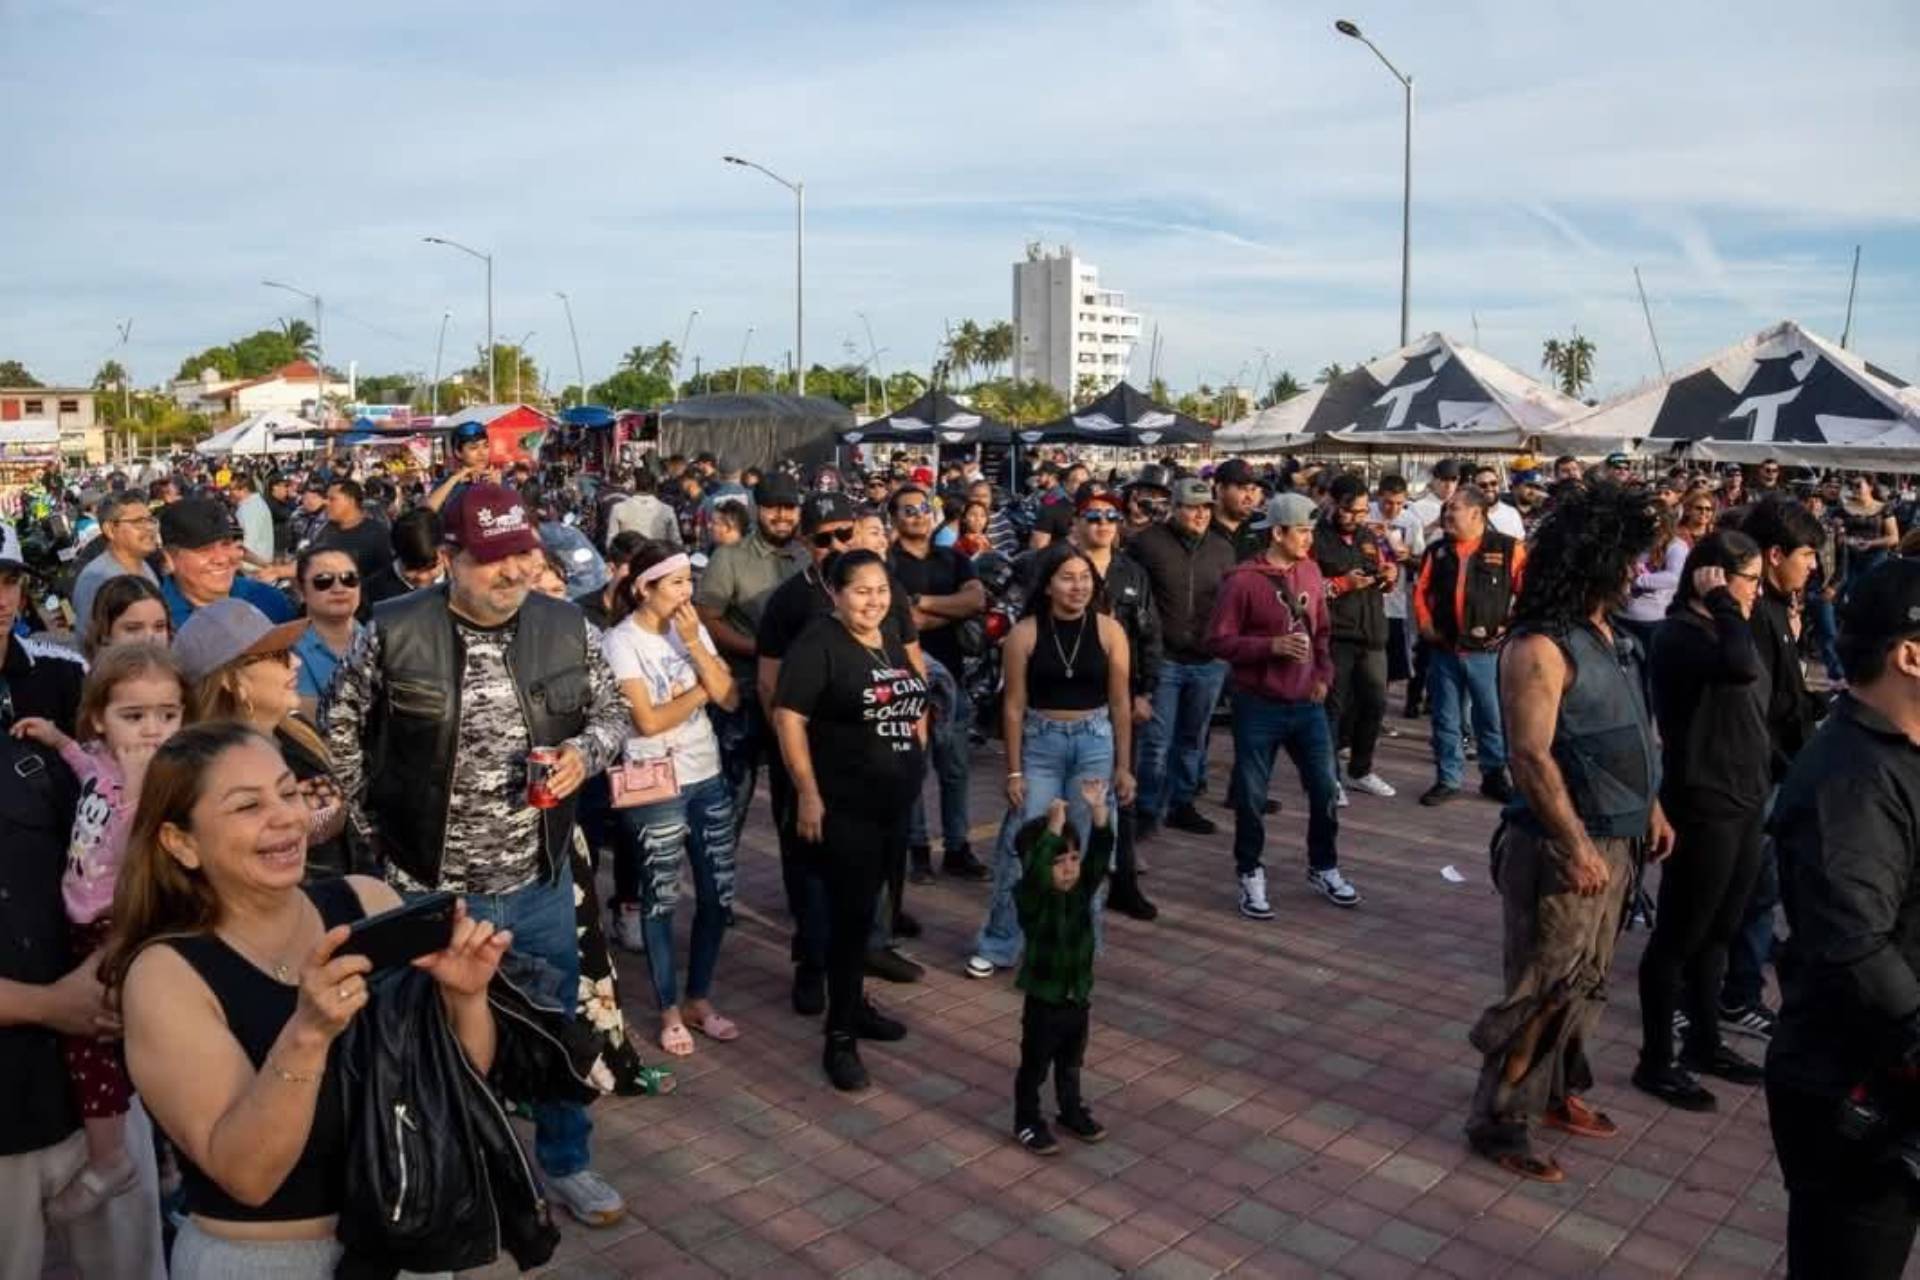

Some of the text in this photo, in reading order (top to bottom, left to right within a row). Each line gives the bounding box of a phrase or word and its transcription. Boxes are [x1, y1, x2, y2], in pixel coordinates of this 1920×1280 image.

[863, 678, 926, 704] SCIAL
[863, 697, 925, 720] SOCIAL
[877, 721, 913, 736] CLU
